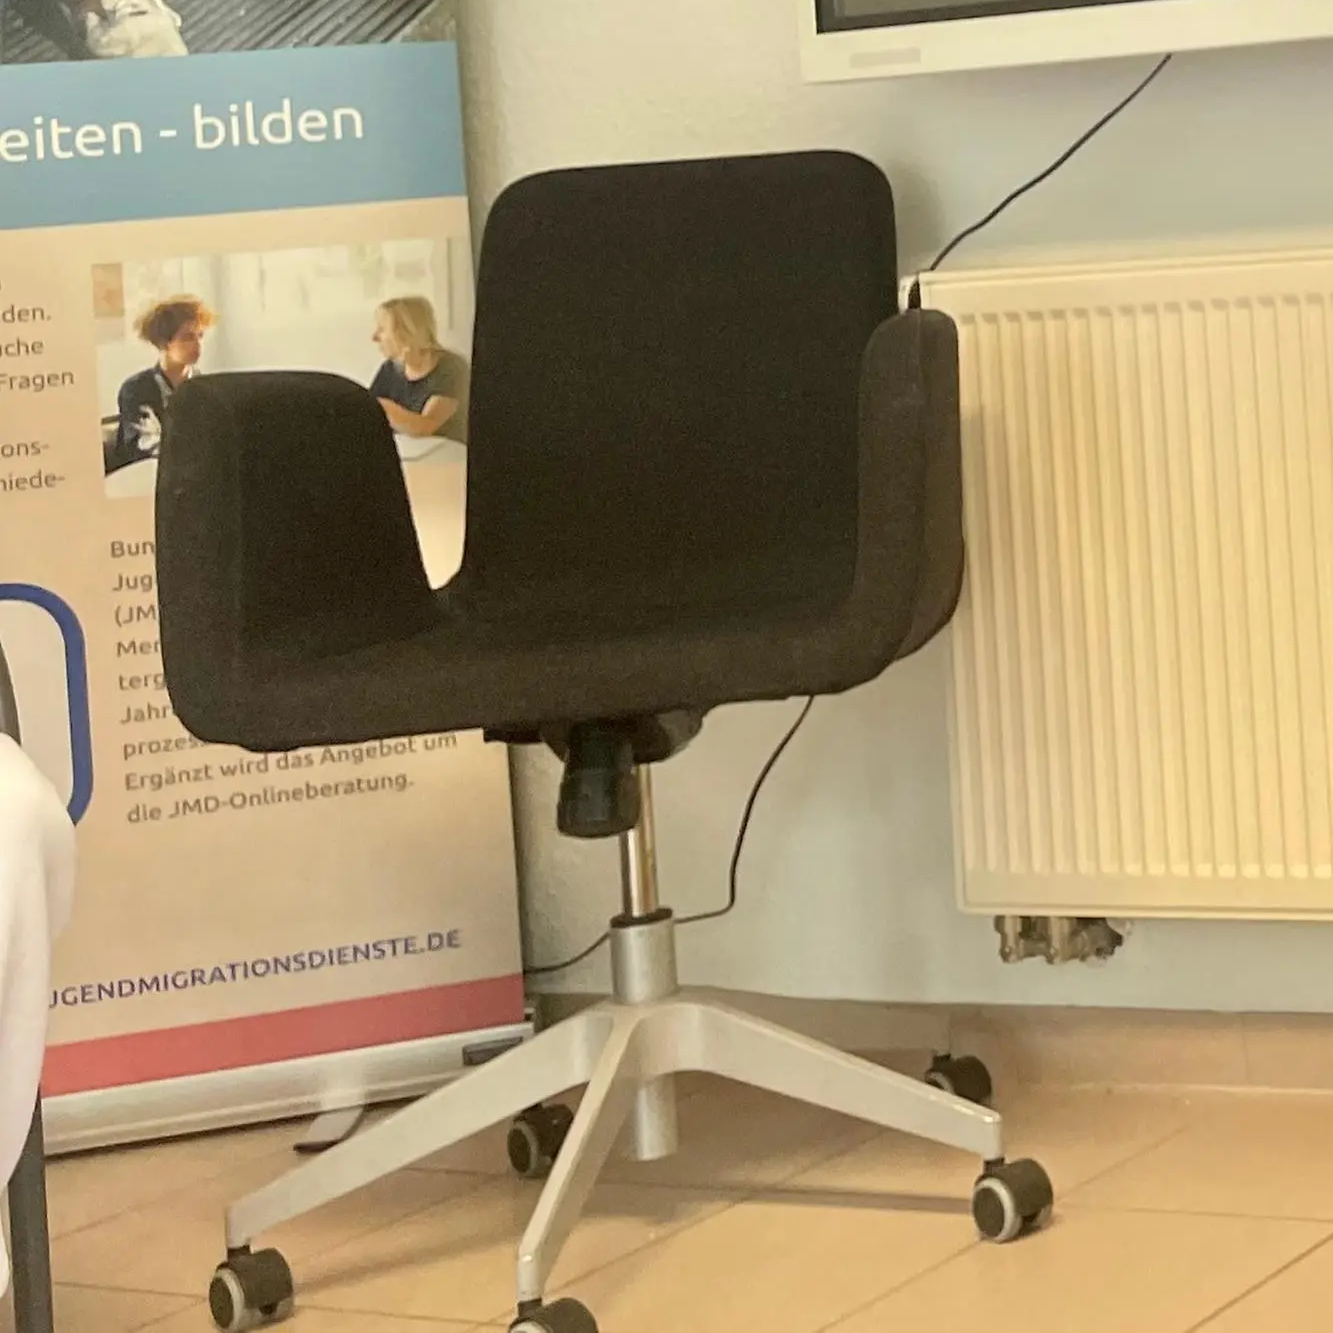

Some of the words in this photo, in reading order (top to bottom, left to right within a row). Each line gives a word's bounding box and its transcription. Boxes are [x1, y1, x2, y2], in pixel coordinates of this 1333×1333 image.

[193, 97, 364, 151] bilden
[124, 766, 214, 792] Ergänzt
[220, 753, 269, 778] wird
[276, 751, 314, 771] das
[320, 734, 417, 765] Angebot
[423, 733, 458, 751] um
[127, 804, 163, 824] die
[168, 772, 415, 820] JMD-Onlineberatung.
